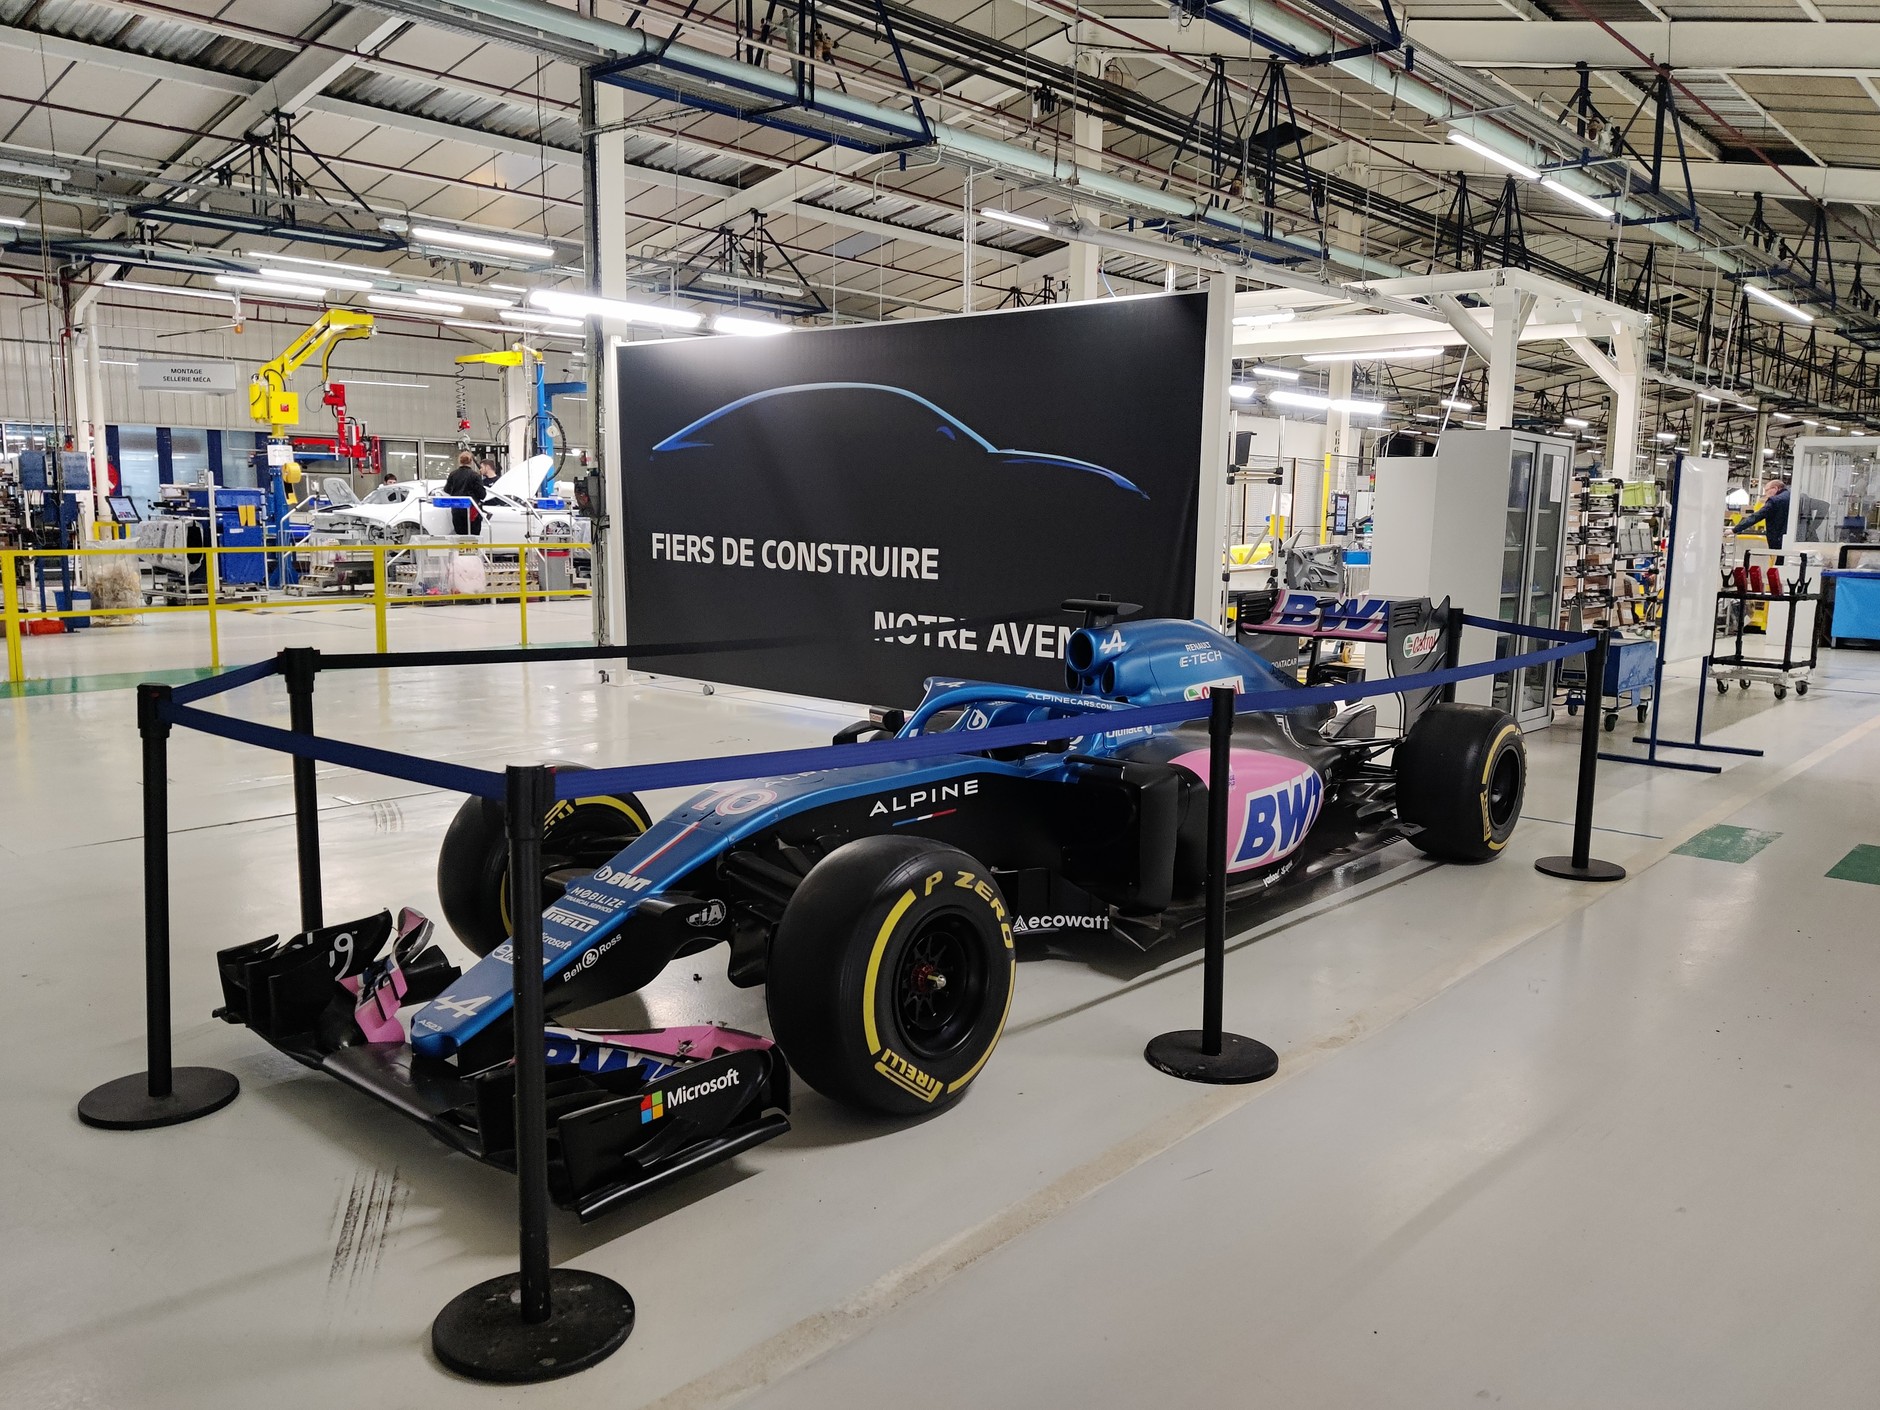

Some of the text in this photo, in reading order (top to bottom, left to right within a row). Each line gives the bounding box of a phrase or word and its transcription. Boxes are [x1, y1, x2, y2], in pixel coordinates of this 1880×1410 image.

[162, 375, 212, 383] SELLERIE MÉCA
[651, 532, 939, 580] FIERS DE CONSTRUIRE
[874, 610, 978, 651] NOTRE
[1184, 641, 1212, 652] RENAULT
[1180, 650, 1223, 668] E-TECH
[1025, 692, 1113, 711] ALPINECARS.COM
[869, 779, 979, 818] ALPINE
[1235, 770, 1323, 863] BWT
[605, 871, 653, 892] BWT
[542, 906, 600, 933] PIRELLI
[924, 870, 1015, 949] P ZERO
[1027, 914, 1110, 930] ecowatt
[562, 962, 583, 983] Bell
[598, 933, 622, 956] Ross
[667, 1068, 740, 1109] Microsoft
[874, 1048, 945, 1104] PIRELLI
